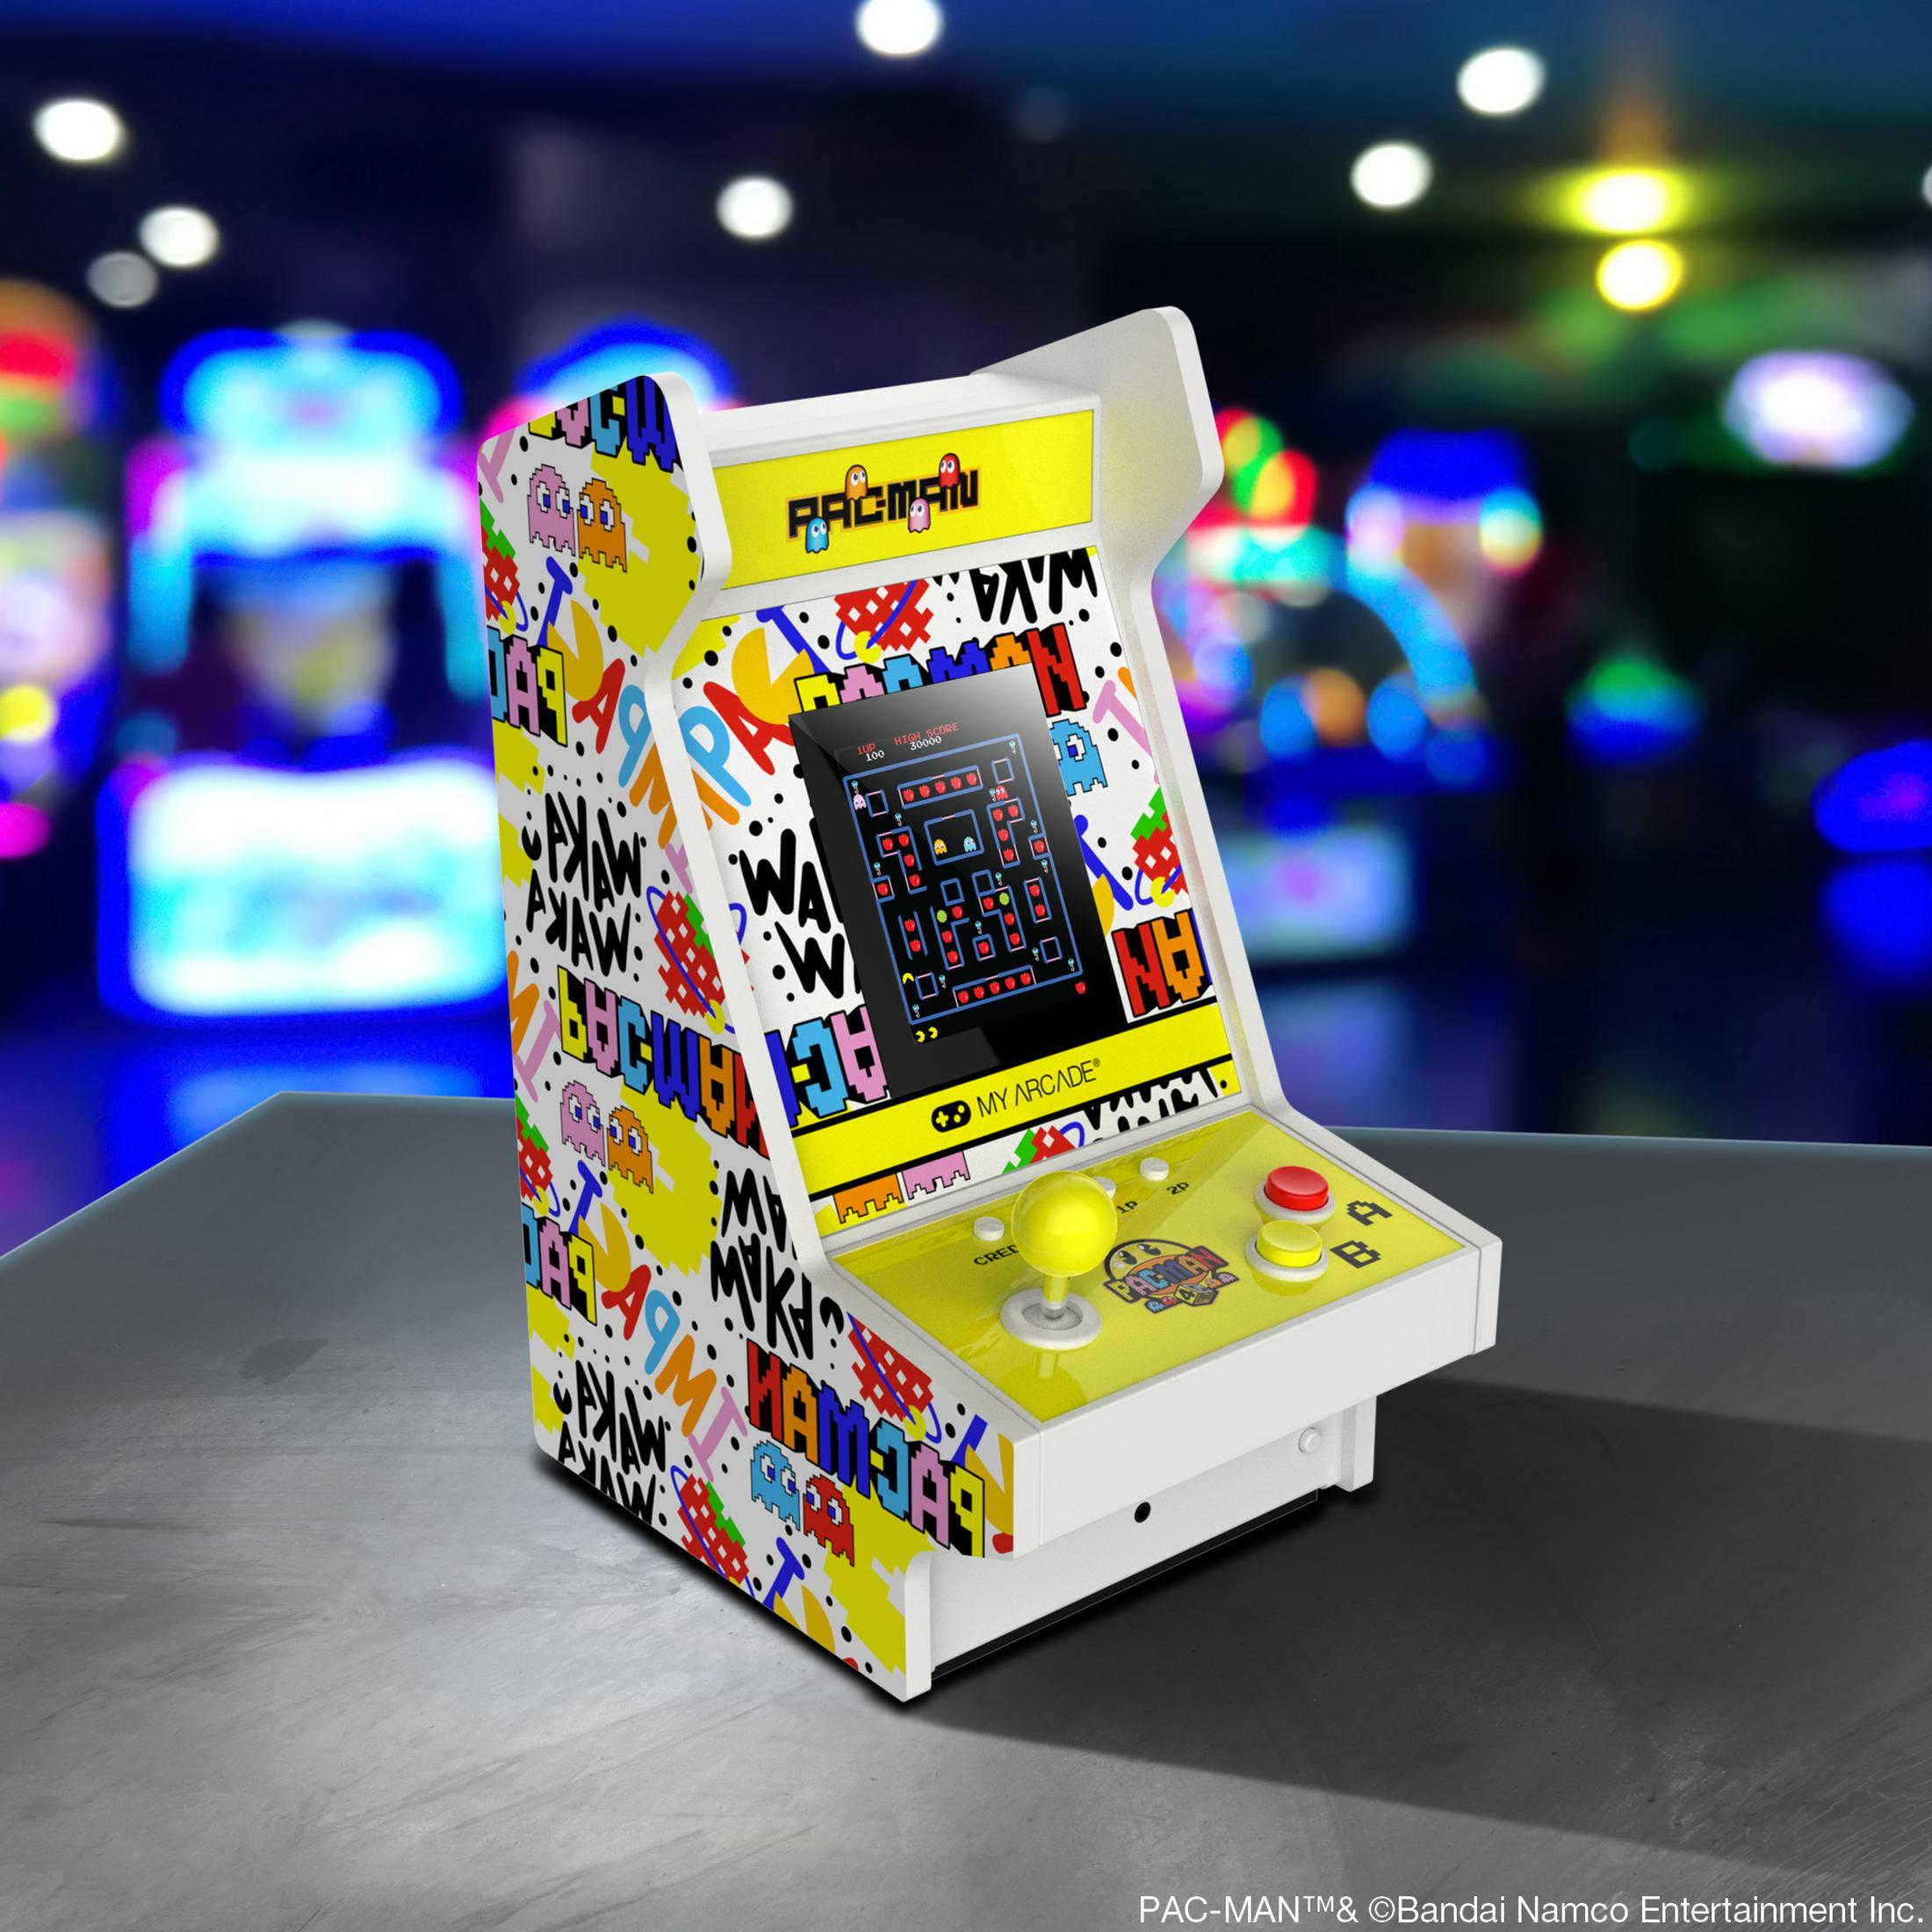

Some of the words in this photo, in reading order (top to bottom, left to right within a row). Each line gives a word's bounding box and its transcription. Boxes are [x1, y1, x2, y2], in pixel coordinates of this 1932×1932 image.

[894, 732, 921, 746] HIGH
[926, 722, 960, 738] SCORE
[910, 735, 942, 751] 30000
[857, 743, 876, 755] 1UP
[866, 750, 885, 761] 100
[977, 1087, 1007, 1117] MY
[1346, 1200, 1394, 1226] A
[1329, 1239, 1381, 1269] B
